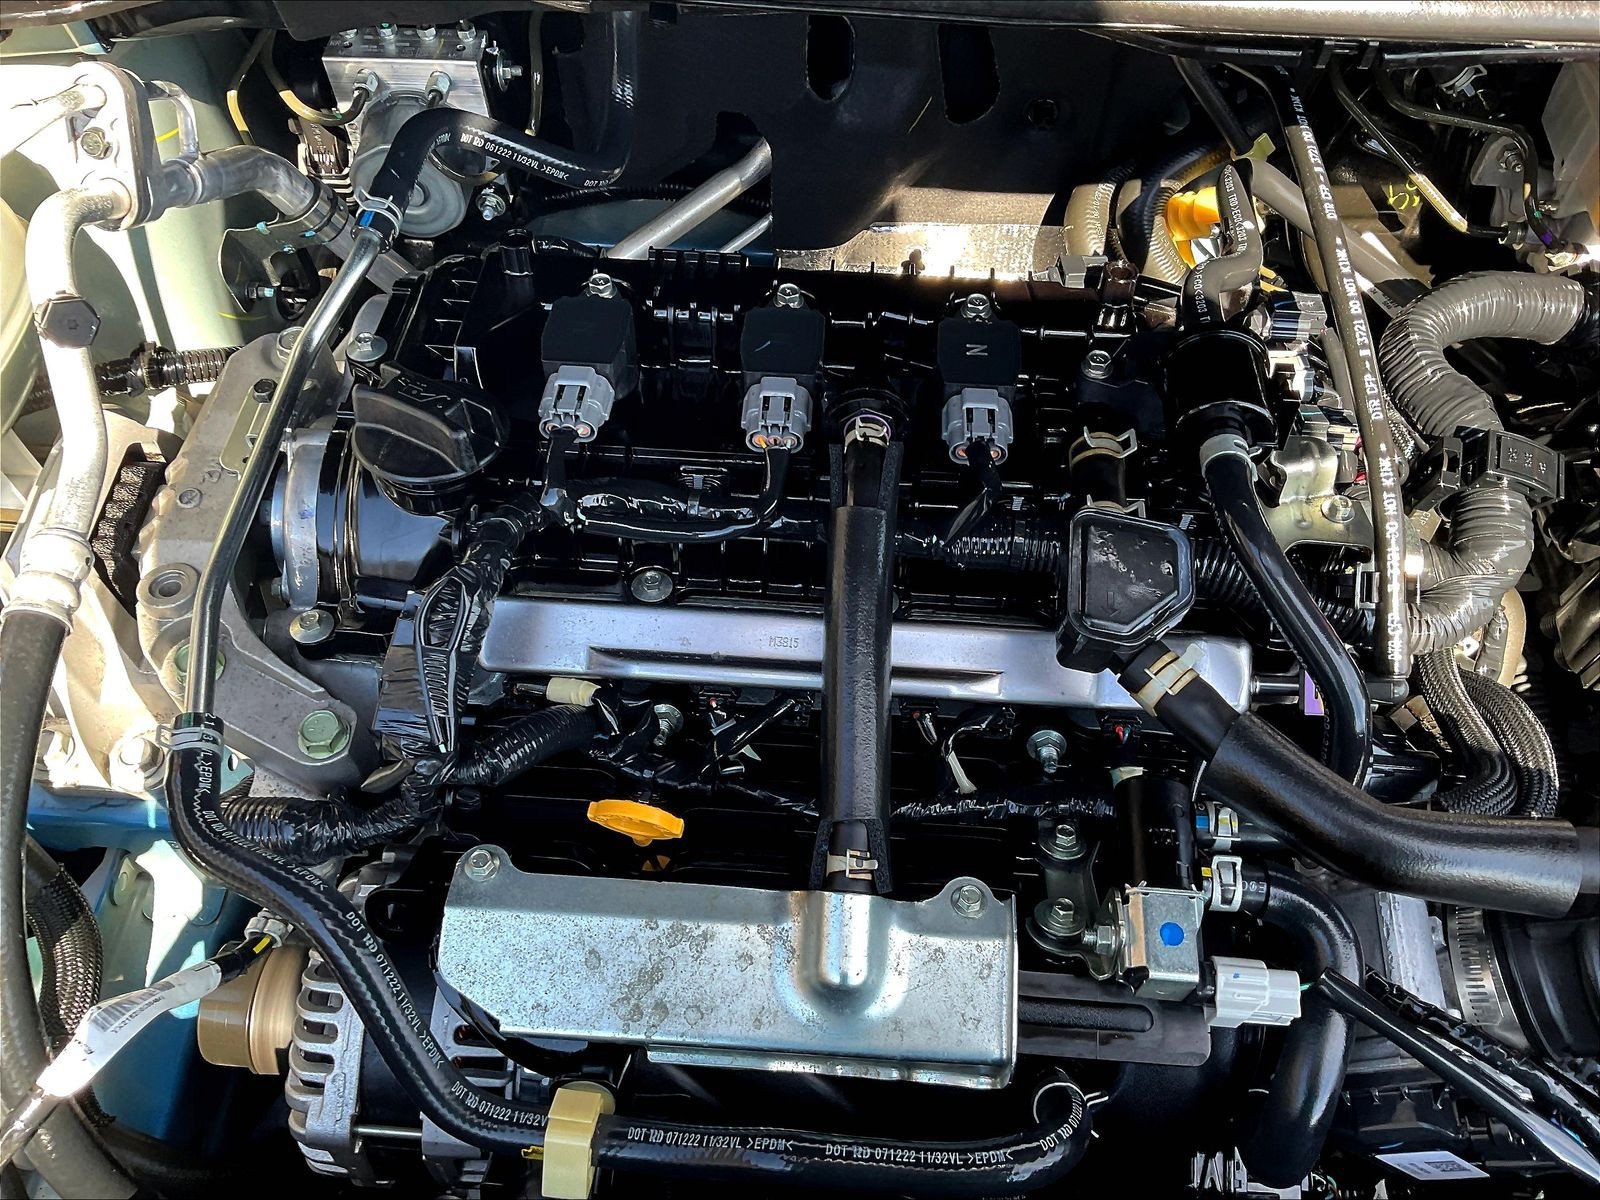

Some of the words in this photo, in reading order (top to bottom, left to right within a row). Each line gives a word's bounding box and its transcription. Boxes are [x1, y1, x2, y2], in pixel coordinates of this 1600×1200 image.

[1336, 249, 1351, 273] KINK
[1343, 277, 1358, 296] NOT
[1353, 319, 1369, 346] 3721
[346, 911, 365, 932] DOT
[376, 953, 401, 993] 071222
[451, 1081, 466, 1099] DOT
[479, 1100, 511, 1121] 071222
[628, 1126, 647, 1142] DOT
[666, 1131, 701, 1146] 071222
[1040, 1133, 1059, 1151] DOT
[825, 1143, 847, 1157] DOT
[875, 1147, 916, 1163] 071222
